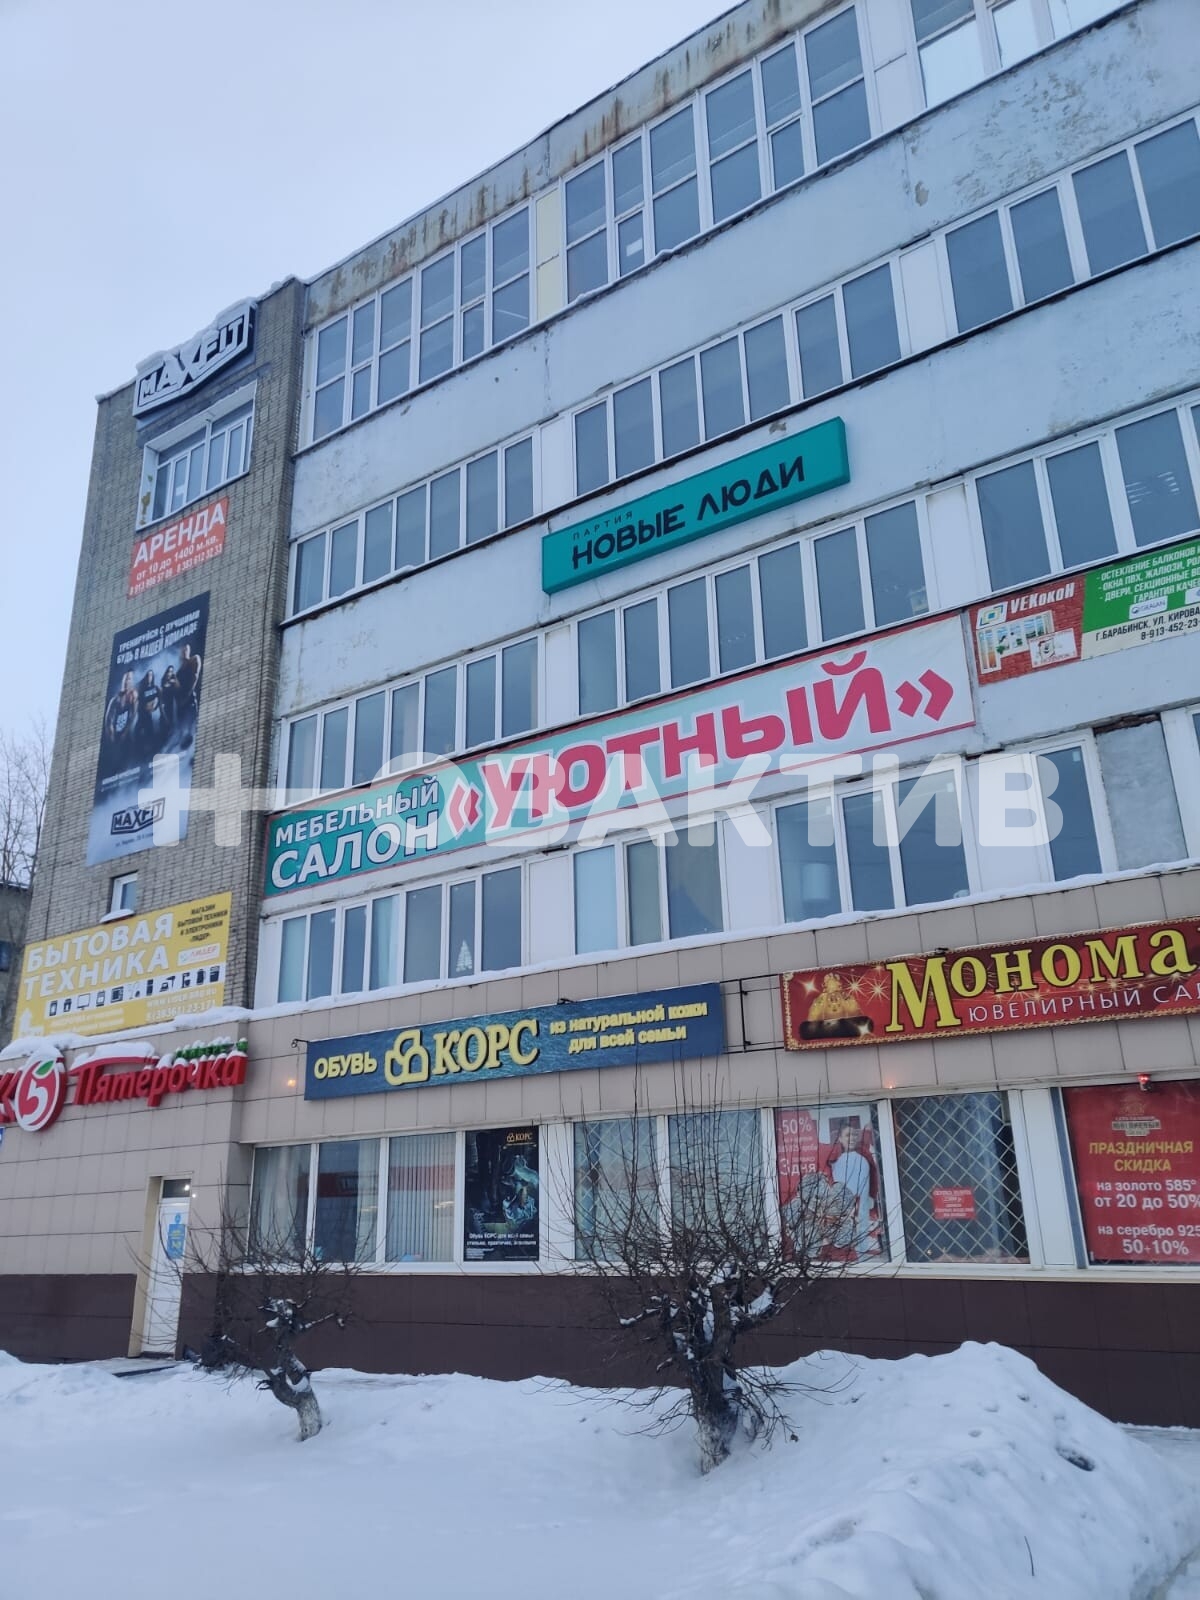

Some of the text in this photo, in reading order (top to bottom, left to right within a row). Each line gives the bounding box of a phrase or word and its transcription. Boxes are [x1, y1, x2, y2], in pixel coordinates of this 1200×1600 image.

[138, 316, 244, 400] MAXFIT
[572, 456, 805, 570] НОВЫЕ ЛЮДИ
[572, 511, 634, 541] ПАРТИЯ
[133, 503, 225, 568] АРЕНДА
[136, 571, 146, 581] от
[149, 562, 158, 574] 10
[159, 558, 171, 572] до
[174, 545, 194, 562] 1400
[1101, 559, 1151, 581] ОСТЕКЛЕНИЕ
[1152, 547, 1196, 566] БАЛКОНОВ
[1103, 577, 1124, 591] ОКНА
[1134, 584, 1175, 604] ГАРАНТИЯ
[1135, 569, 1190, 593] СЕКЦИОННЫЕ
[1168, 606, 1200, 622] КИРОВА
[119, 627, 159, 653] ТРЕНИРУЙСЯ
[275, 650, 955, 848] МЕБЕЛЬНЫЙ «УЮТНЫЙ»
[270, 810, 440, 889] САЛОН
[27, 912, 174, 973] БЫТОВАЯ
[24, 945, 169, 1000] ТЕХНИКА
[886, 928, 1200, 1032] Монома
[968, 982, 1200, 1023] ЮВЕЛИРНЫЙ СА
[313, 1002, 708, 1080] ОБУВЬ КОРС из натуральной кожи
[568, 1025, 687, 1055] для всей семьи
[515, 1132, 533, 1142] КОРС
[1089, 1140, 1193, 1156] ПРАЗДНИЧНАЯ
[1114, 1159, 1172, 1174] СКИДКА
[1097, 1179, 1197, 1192] на золото 585°
[1095, 1193, 1200, 1211] от 20 до 50%
[1097, 1225, 1113, 1236] на
[1117, 1224, 1174, 1239] серебро
